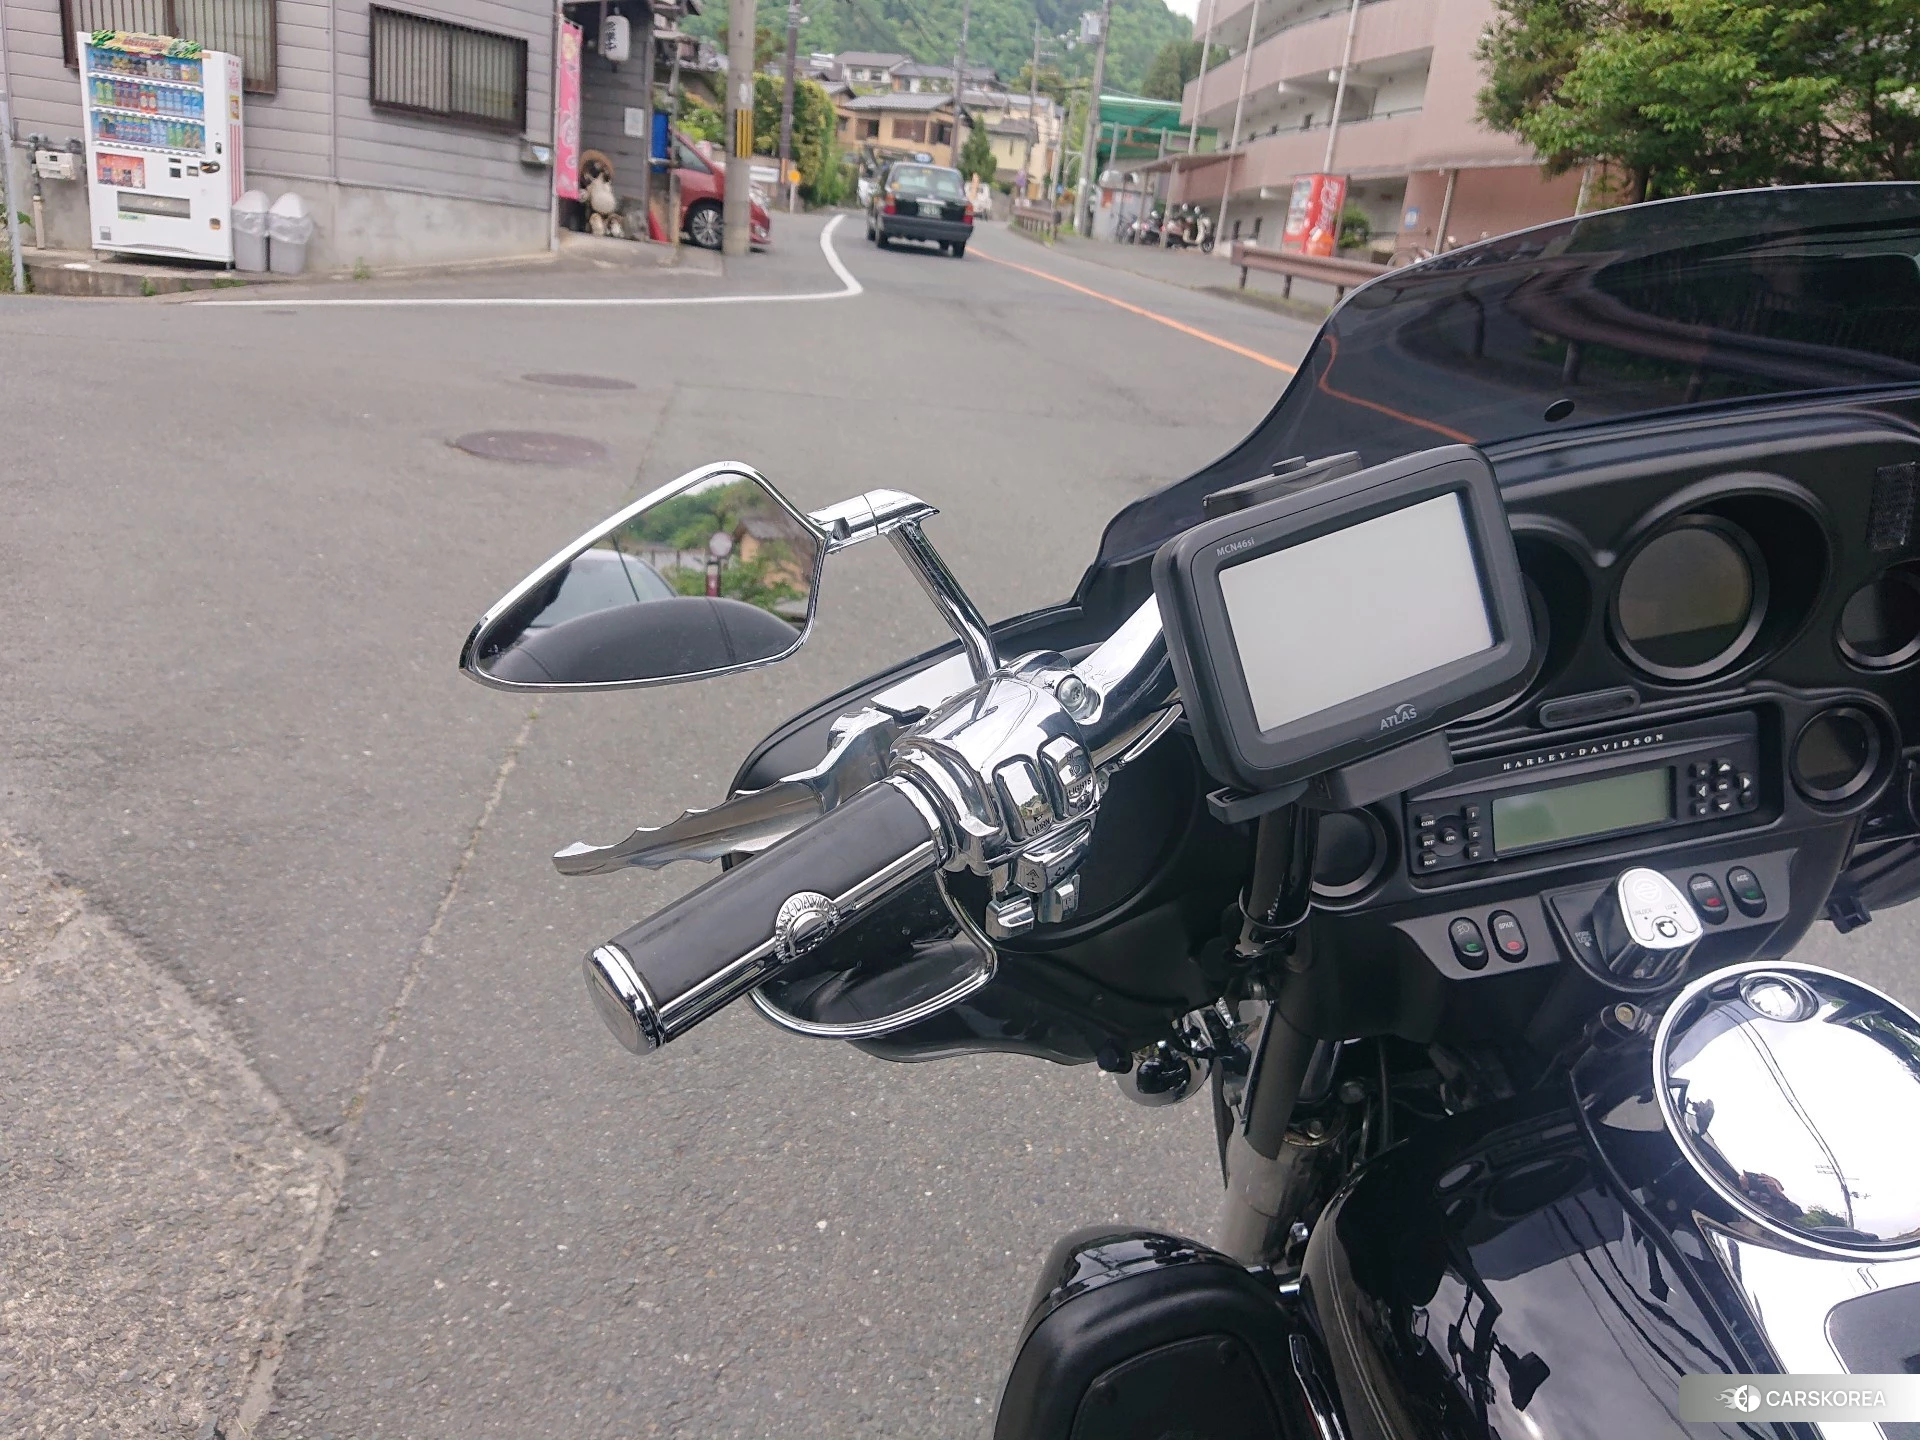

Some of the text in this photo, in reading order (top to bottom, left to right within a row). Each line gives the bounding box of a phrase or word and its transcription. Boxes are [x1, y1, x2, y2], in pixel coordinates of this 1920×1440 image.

[1216, 536, 1255, 557] MCN46si
[1380, 707, 1418, 731] ATLAS
[1503, 733, 1663, 771] HARLEY-DAVIDSON
[1031, 819, 1050, 834] HORN
